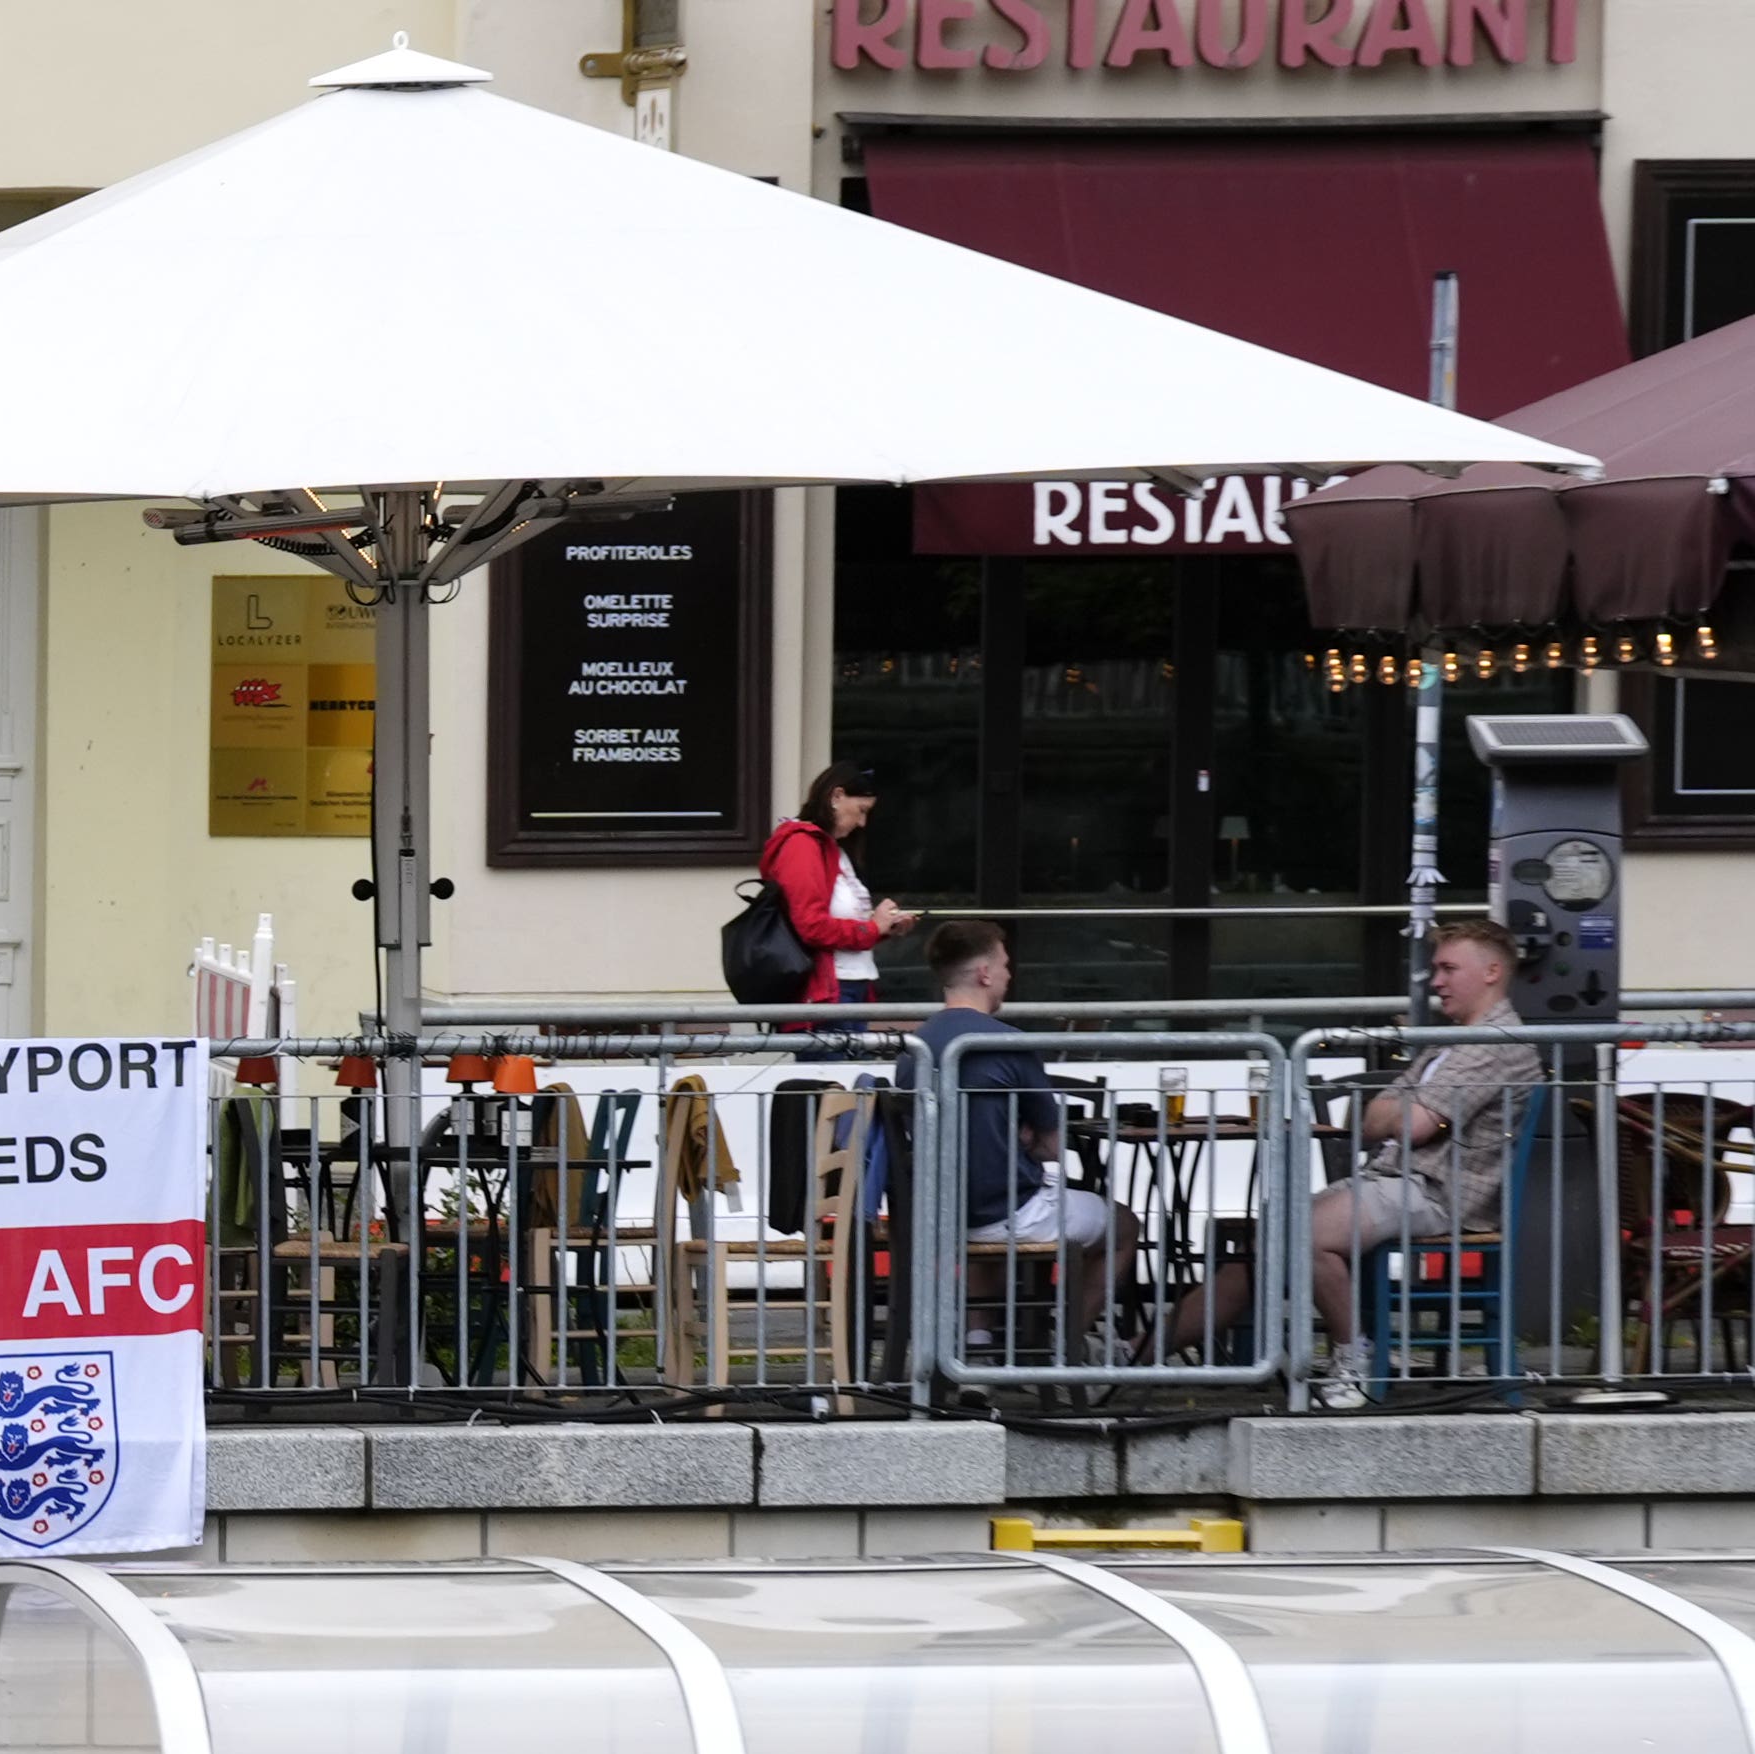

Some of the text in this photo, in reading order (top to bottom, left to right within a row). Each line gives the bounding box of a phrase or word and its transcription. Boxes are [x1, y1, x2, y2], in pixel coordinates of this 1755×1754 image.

[832, 0, 1577, 69] RESTAURANT
[1033, 475, 1349, 545] RESTAU
[566, 545, 693, 561] PROFITEROLES
[583, 594, 673, 610] OMELETTE
[587, 613, 670, 628] SURPRISE
[218, 635, 302, 646] LOCALYZER
[581, 661, 674, 677] MOELLEUX
[568, 680, 688, 695] AU CHOCOLAT
[574, 729, 680, 744] SORBET AUX
[572, 747, 682, 762] FRAMBOISES
[22, 1244, 194, 1317] AFC
